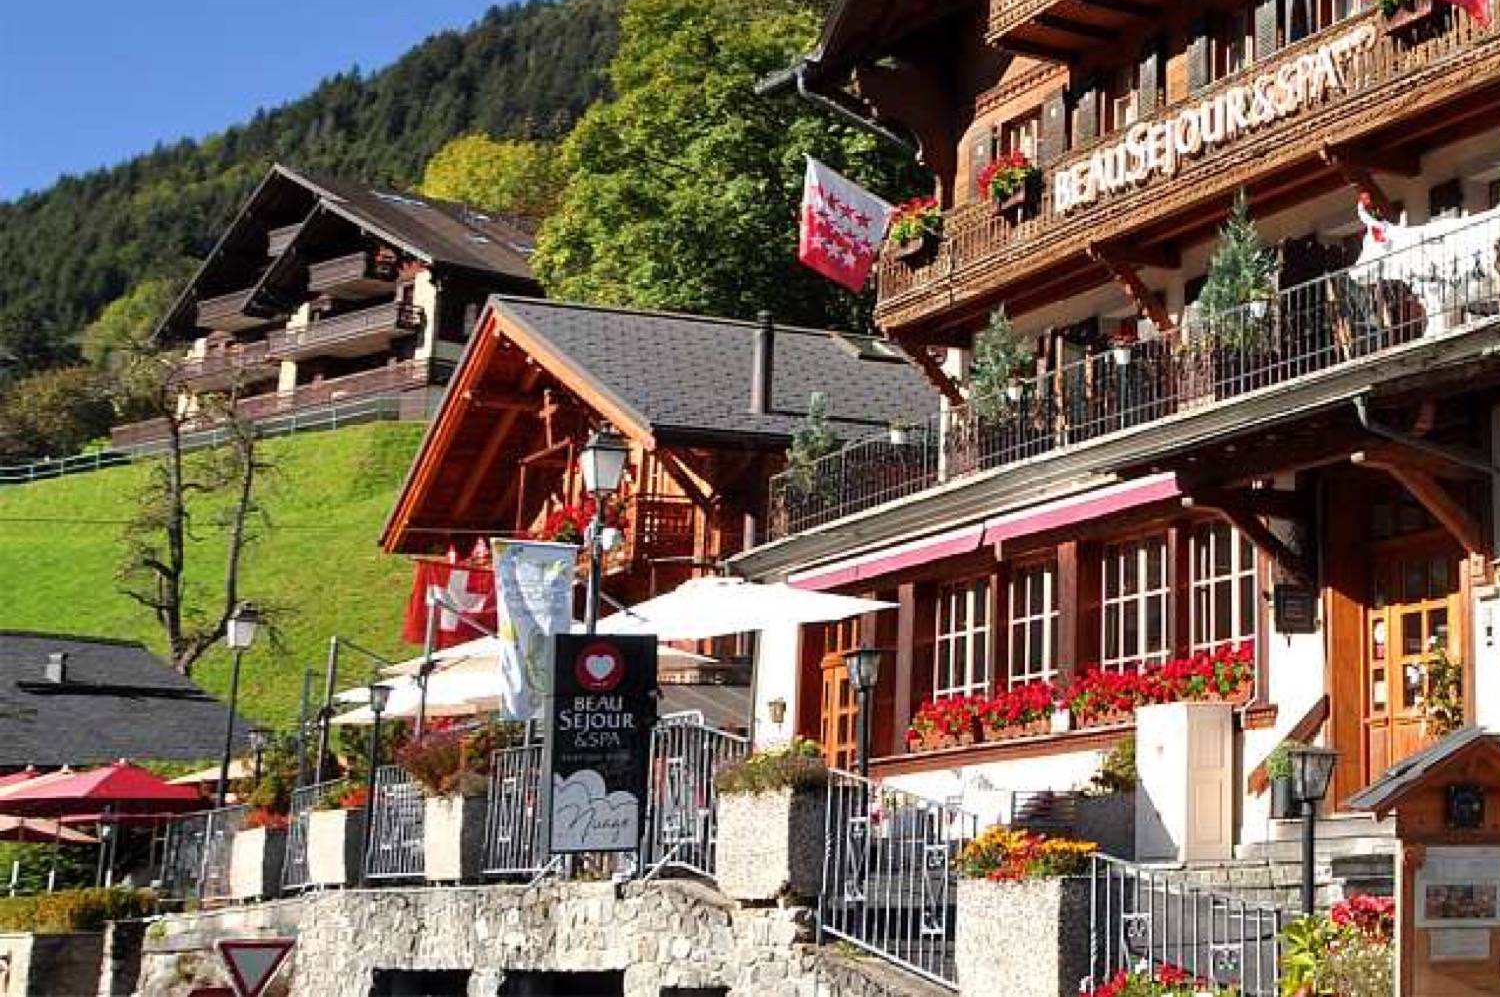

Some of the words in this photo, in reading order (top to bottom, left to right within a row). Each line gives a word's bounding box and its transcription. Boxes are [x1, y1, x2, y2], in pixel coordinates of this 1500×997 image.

[1054, 142, 1126, 212] BEAU
[1124, 86, 1251, 177] SEJOUR
[574, 696, 623, 712] BEAU
[559, 708, 634, 732] SEJOUR
[574, 732, 621, 747] &SPA
